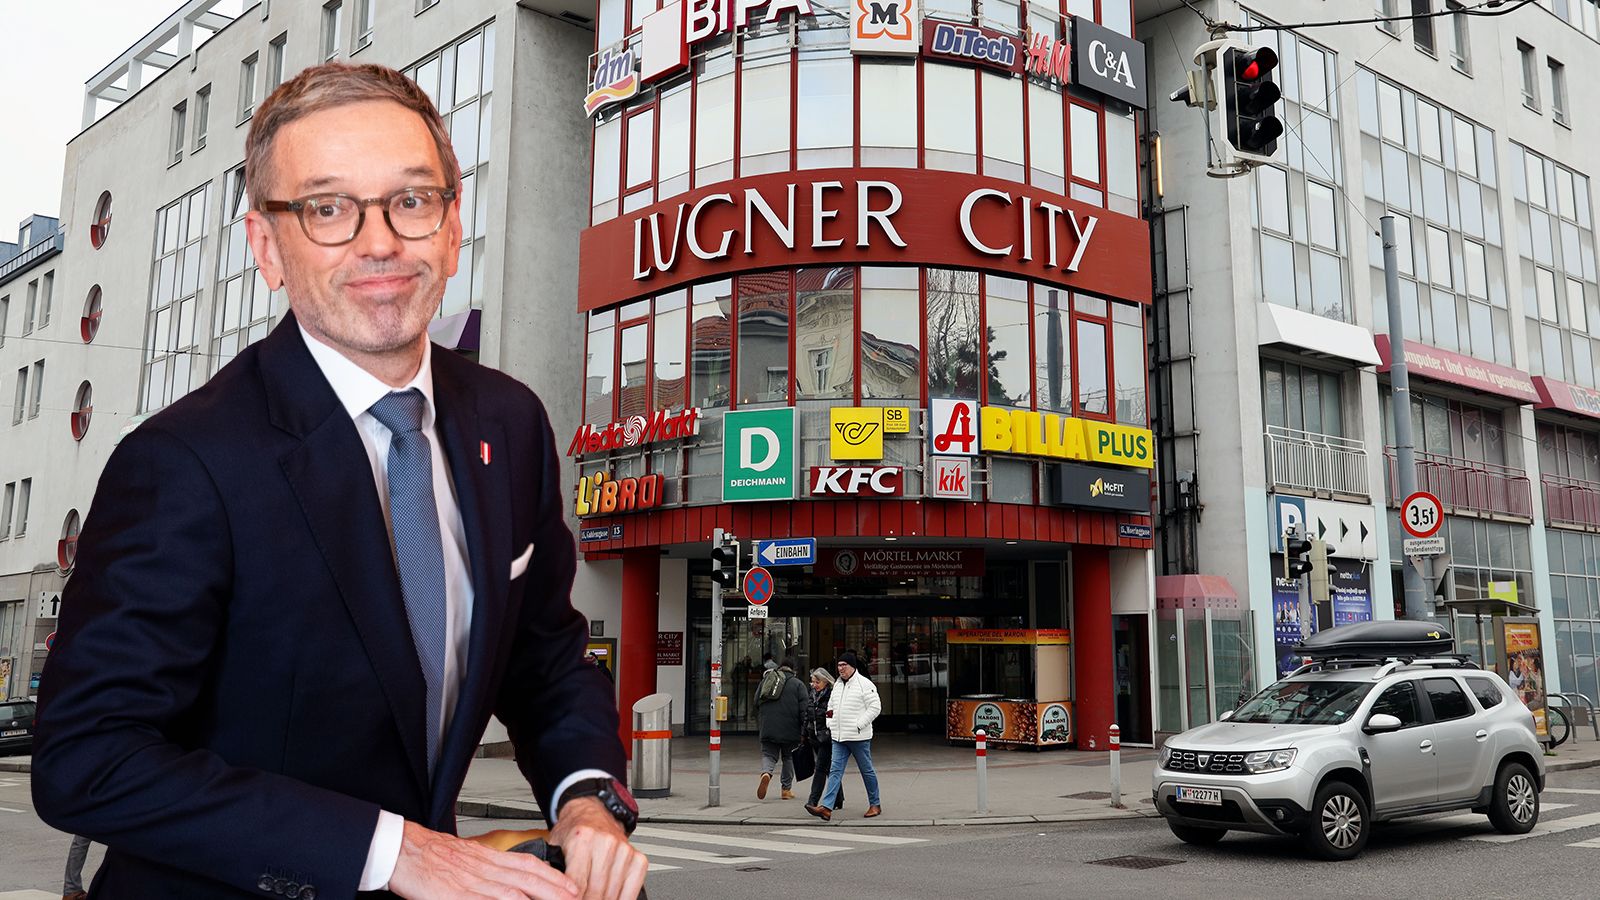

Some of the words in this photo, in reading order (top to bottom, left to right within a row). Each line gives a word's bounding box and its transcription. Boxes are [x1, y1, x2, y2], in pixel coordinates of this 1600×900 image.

[870, 2, 899, 26] M
[932, 24, 1016, 66] DiTech
[1027, 32, 1072, 86] H&M
[594, 49, 632, 91] dm
[1088, 39, 1137, 90] C&A
[632, 180, 909, 281] LUGNER
[959, 188, 1100, 273] CITY
[1404, 350, 1444, 371] omputer.
[1444, 357, 1465, 377] Und
[1465, 363, 1488, 383] nicht
[886, 409, 903, 420] SB
[981, 406, 1088, 461] BILLA
[1098, 430, 1148, 460] PLUS
[740, 427, 781, 472] D
[730, 477, 786, 488] DEICHMANN
[812, 467, 900, 494] KFC
[938, 463, 965, 493] kik
[1103, 482, 1125, 493] McFIT
[1280, 502, 1303, 538] P
[775, 546, 809, 559] EINBAHN
[863, 549, 914, 562] MÖRTEL
[916, 550, 963, 562] MARKT
[890, 563, 923, 571] Gastronomie
[749, 608, 767, 618] Anfang
[1181, 789, 1188, 798] W
